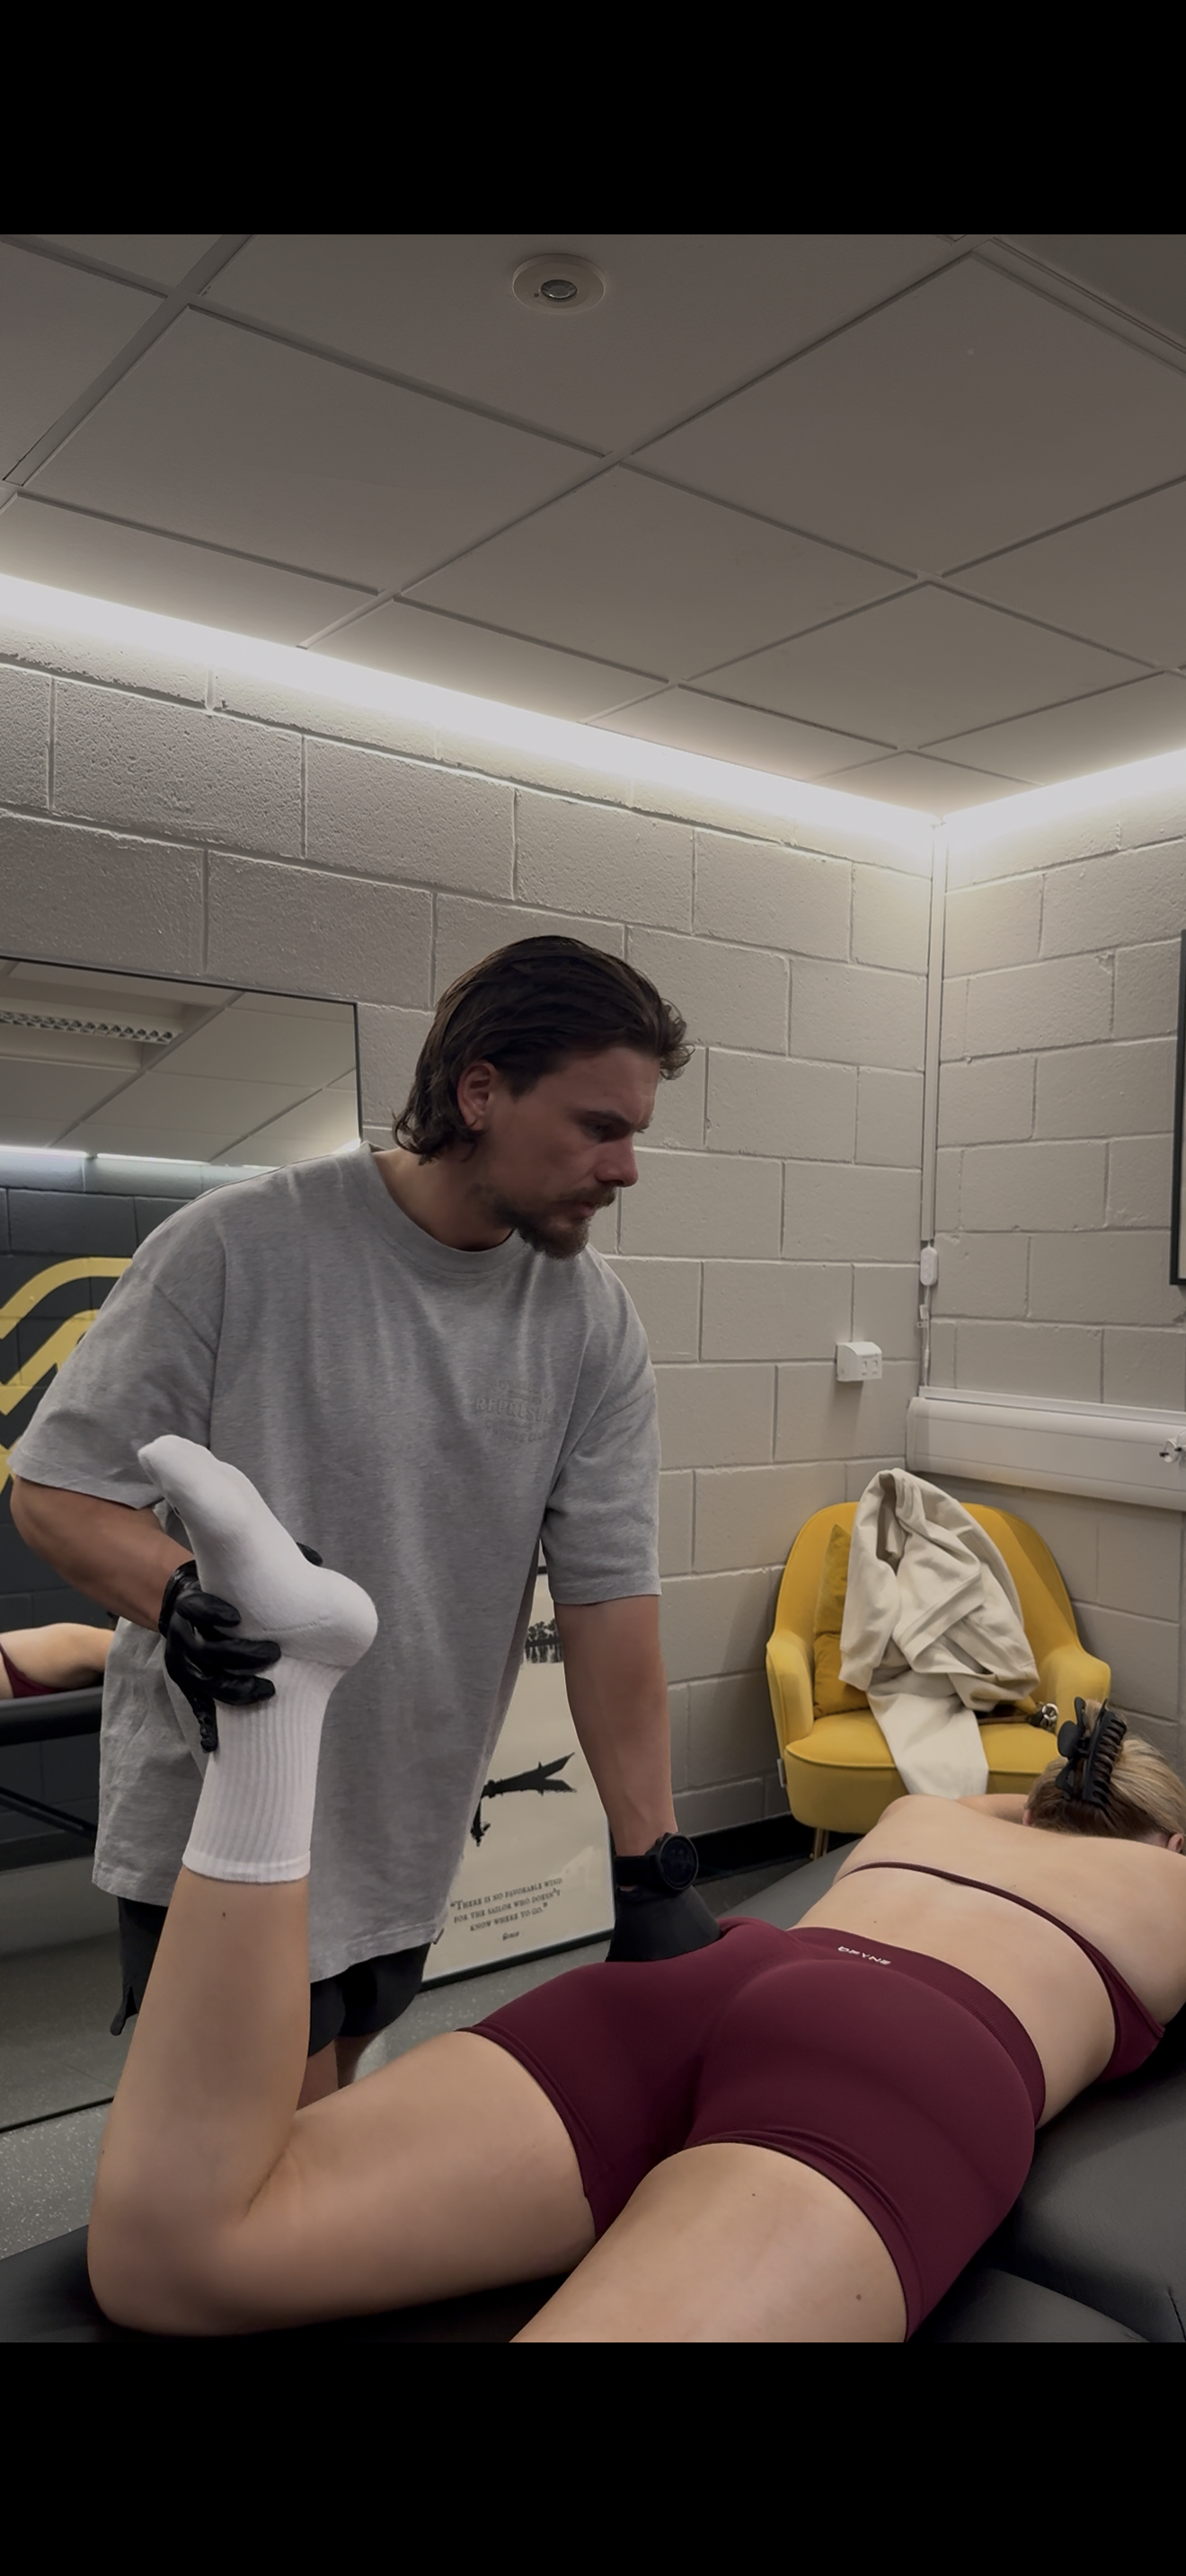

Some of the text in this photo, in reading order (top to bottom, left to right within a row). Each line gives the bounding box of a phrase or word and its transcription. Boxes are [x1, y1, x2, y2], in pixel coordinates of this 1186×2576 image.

[484, 1895, 491, 1903] IS
[492, 1892, 504, 1901] NO
[505, 1883, 543, 1898] FAVORABLE
[544, 1877, 563, 1887] WIND
[454, 1914, 468, 1924] FOR
[470, 1910, 485, 1919] THE
[487, 1903, 512, 1915] SAILOR
[514, 1898, 531, 1908] WHO
[470, 1920, 491, 1932] KNOW
[493, 1913, 518, 1925] WHERE
[520, 1910, 530, 1919] TO
